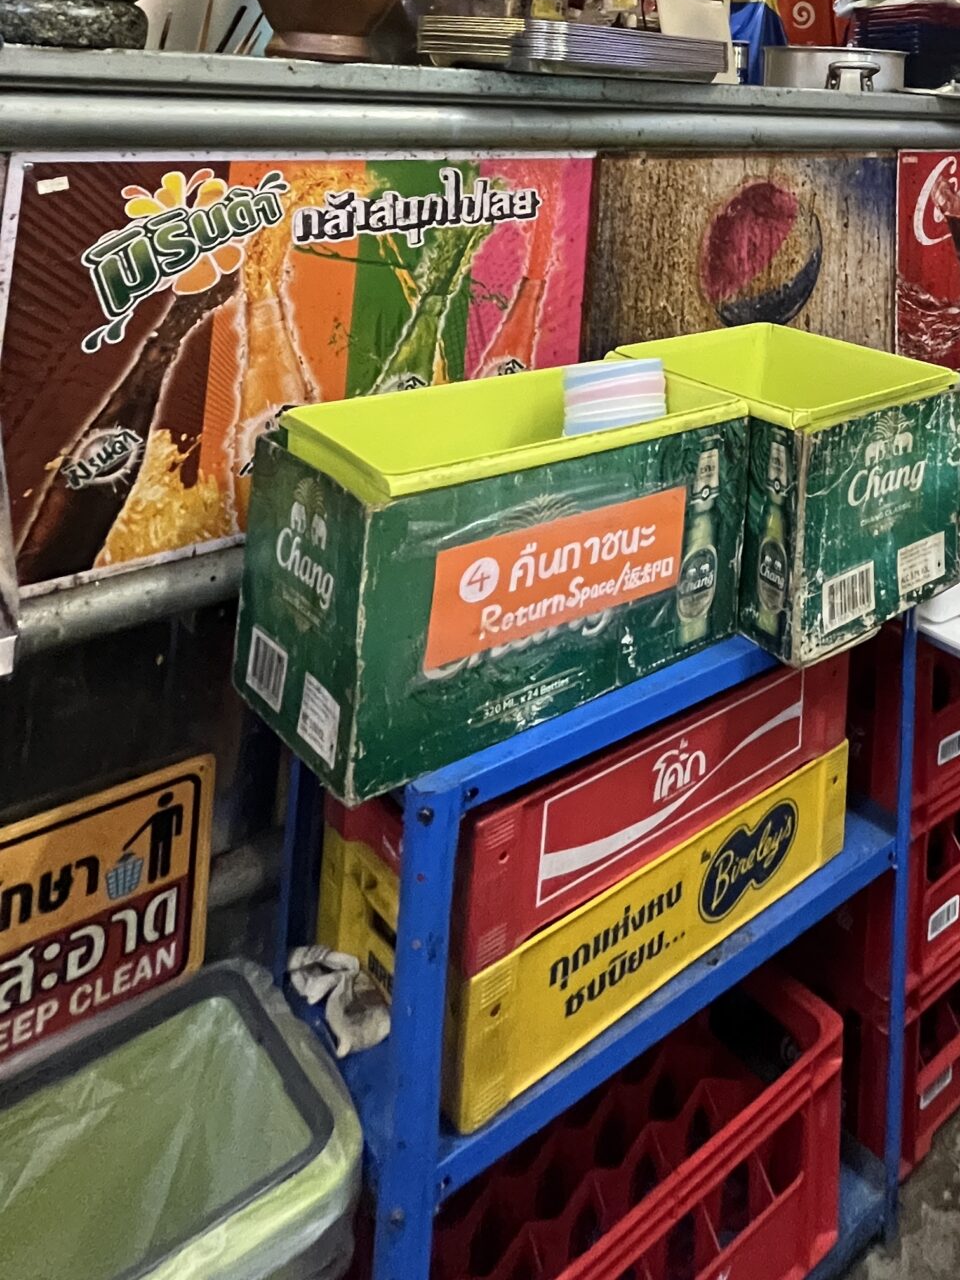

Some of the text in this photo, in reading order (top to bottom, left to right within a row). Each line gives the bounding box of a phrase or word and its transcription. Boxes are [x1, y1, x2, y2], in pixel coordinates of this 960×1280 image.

[293, 168, 541, 246] กล้าสนุกไปเลย
[81, 186, 283, 318] มิรินด้า
[848, 456, 929, 512] Chang
[275, 526, 334, 610] Chang
[759, 562, 786, 591] Chang
[652, 748, 707, 803] โค้ก
[711, 814, 795, 912] Bireley's
[68, 942, 178, 1017] CLEAN
